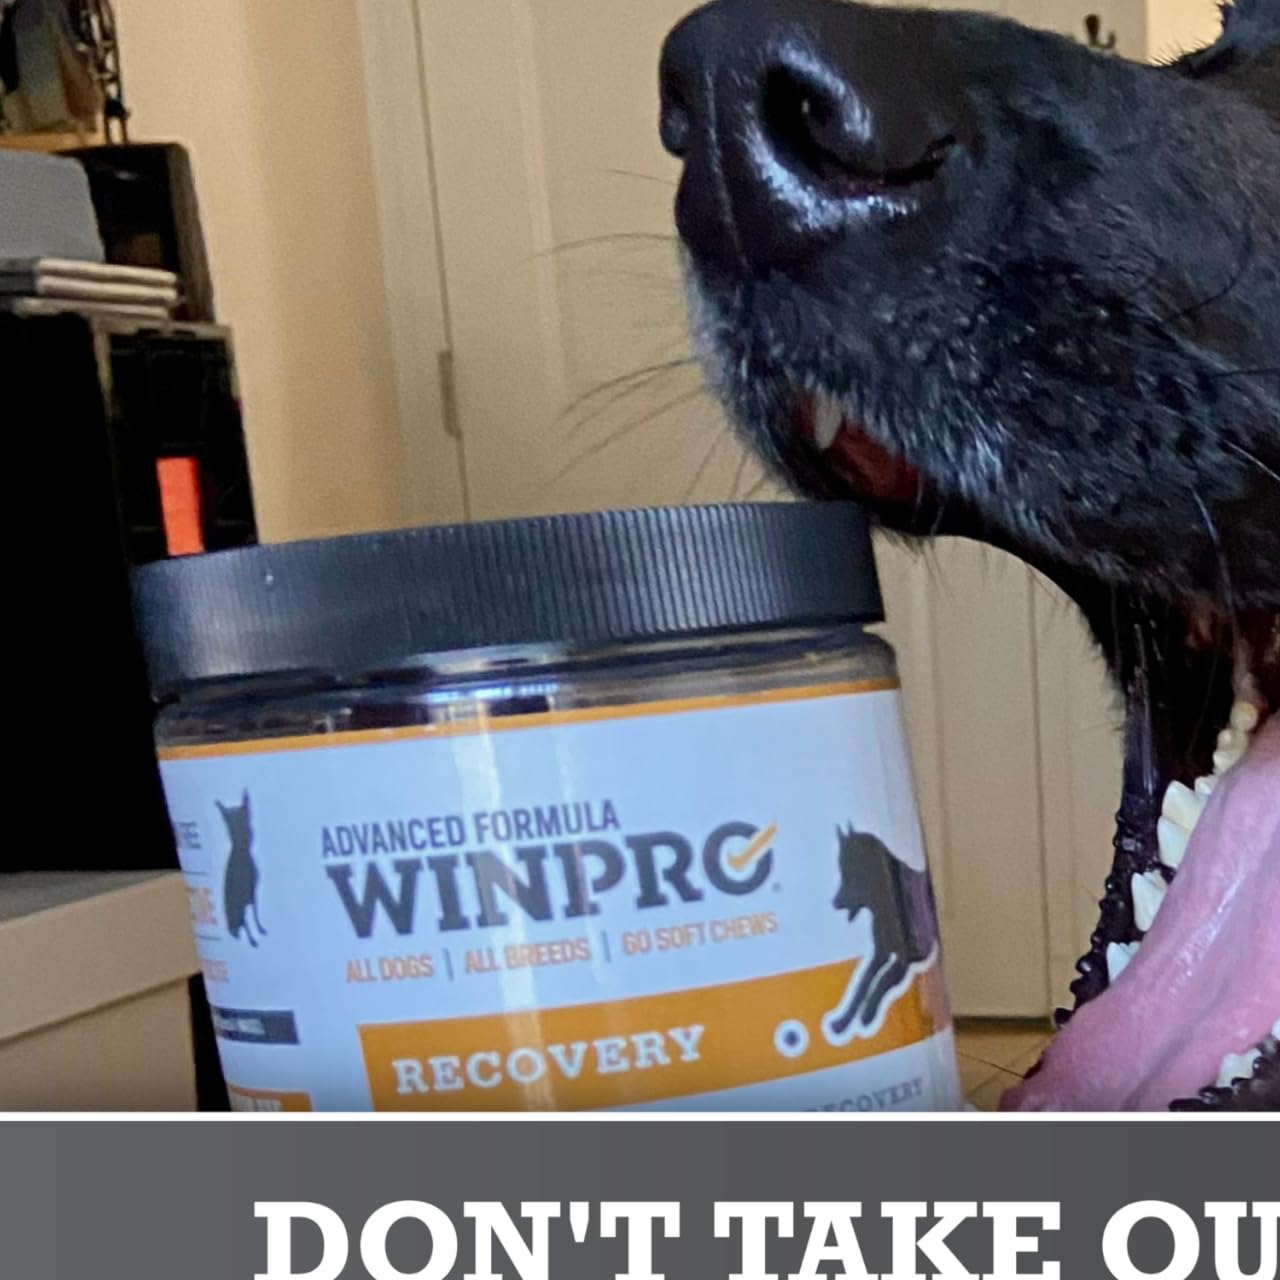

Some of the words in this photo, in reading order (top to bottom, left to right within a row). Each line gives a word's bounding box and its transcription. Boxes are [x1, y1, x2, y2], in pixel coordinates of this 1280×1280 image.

[322, 814, 466, 859] ADVANCED
[474, 799, 621, 843] FORMULA
[325, 820, 776, 939] WINPRO
[464, 946, 500, 974] ALL
[504, 938, 591, 967] BREEDS
[622, 928, 652, 956] 60
[656, 922, 706, 951] SOFT
[710, 912, 778, 942] CHEWS
[346, 959, 376, 983] ALL
[380, 954, 433, 982] DOGS
[392, 1025, 704, 1095] RECOVERY
[803, 1077, 924, 1112] COVERY
